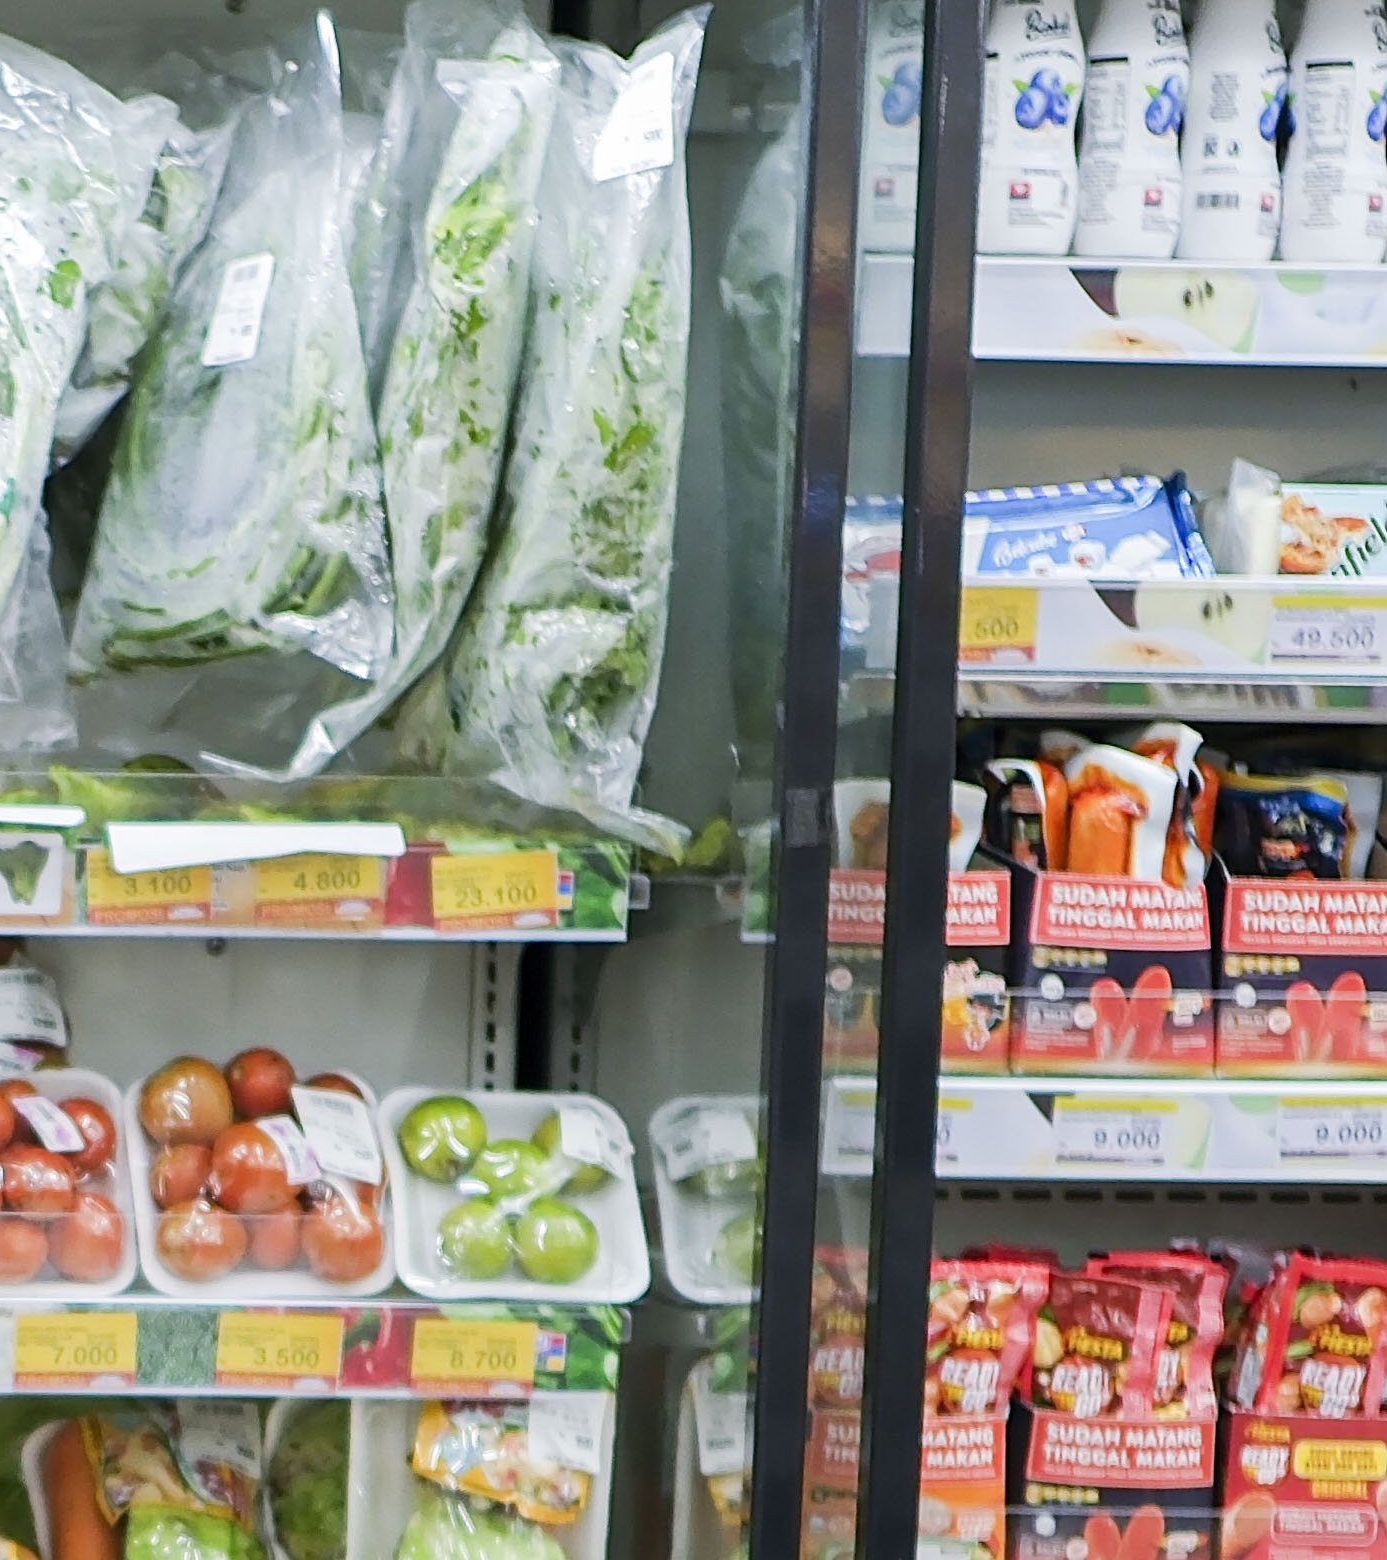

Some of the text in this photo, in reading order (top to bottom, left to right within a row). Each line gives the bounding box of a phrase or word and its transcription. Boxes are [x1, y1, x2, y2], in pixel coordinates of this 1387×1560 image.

[126, 875, 192, 897] 3.100
[293, 871, 361, 891] 4.800
[829, 880, 886, 902] SUDA
[948, 881, 998, 904] TANG
[455, 885, 538, 909] 23.100
[1050, 883, 1127, 909] SUDAH
[1242, 889, 1320, 913] SUDAH
[946, 904, 998, 925] AKAN
[1047, 905, 1136, 930] TINGGAL
[1240, 910, 1331, 934] TINGGAL
[52, 1347, 119, 1365] 7.000
[254, 1348, 320, 1369] 3.500
[451, 1349, 517, 1371] 8.700
[1046, 1422, 1203, 1448] SUDAH MATANG
[1043, 1445, 1201, 1468] TINGGAL MAKAN
